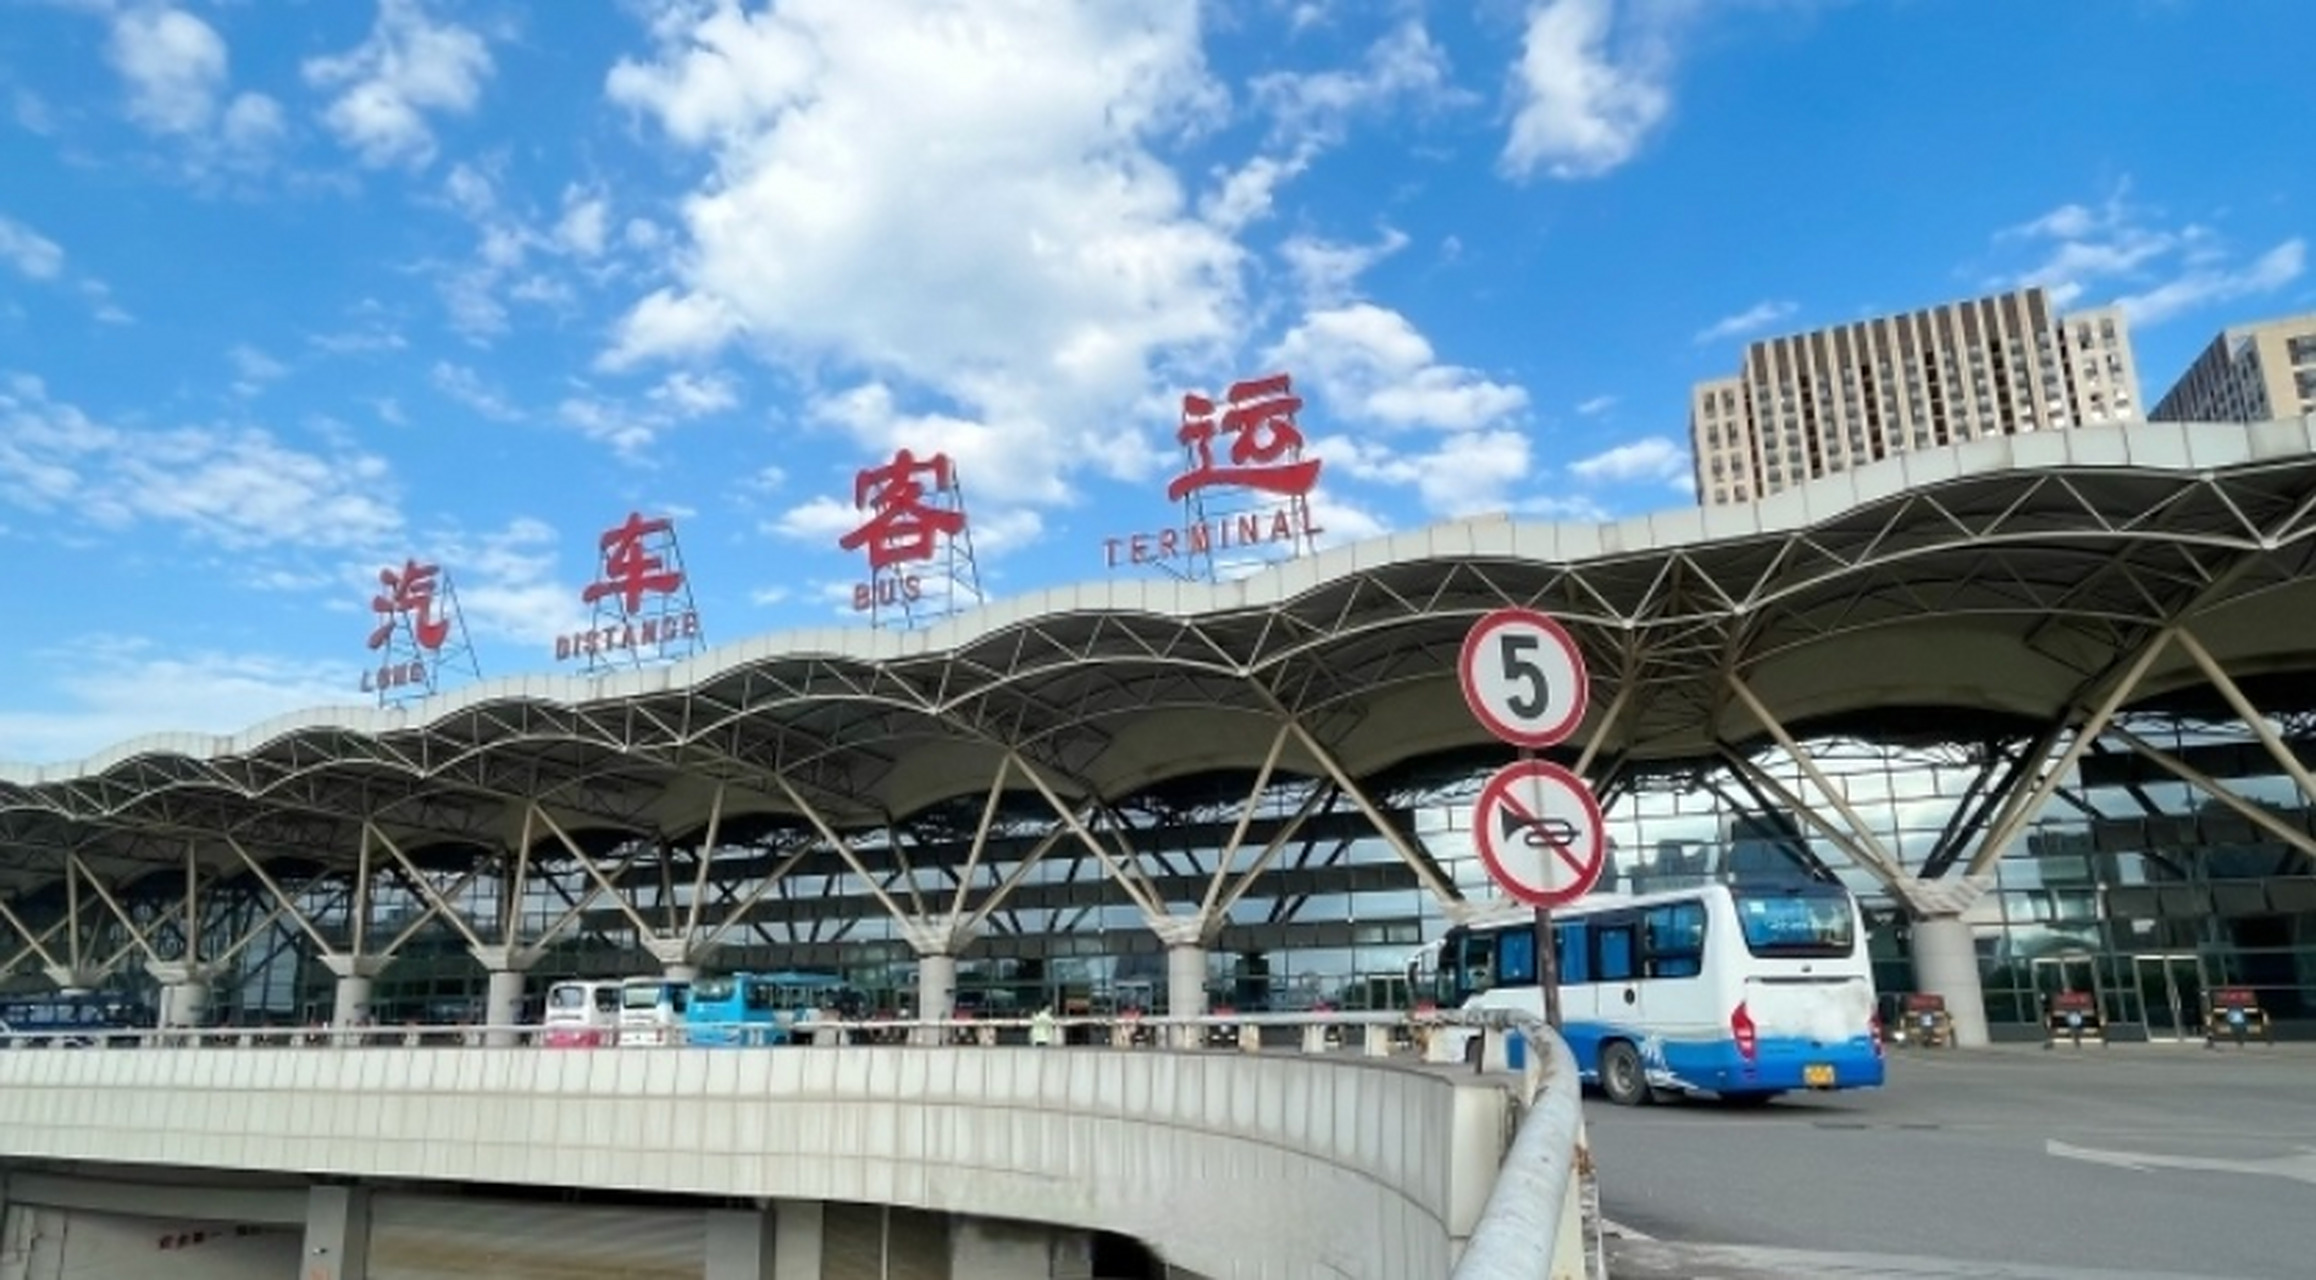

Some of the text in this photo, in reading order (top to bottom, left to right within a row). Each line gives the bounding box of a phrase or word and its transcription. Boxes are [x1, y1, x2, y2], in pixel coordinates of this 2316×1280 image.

[556, 612, 697, 661] DISTANCE
[854, 575, 921, 612] BUS
[1103, 505, 1323, 567] TERMINAL
[1500, 634, 1549, 719] 5
